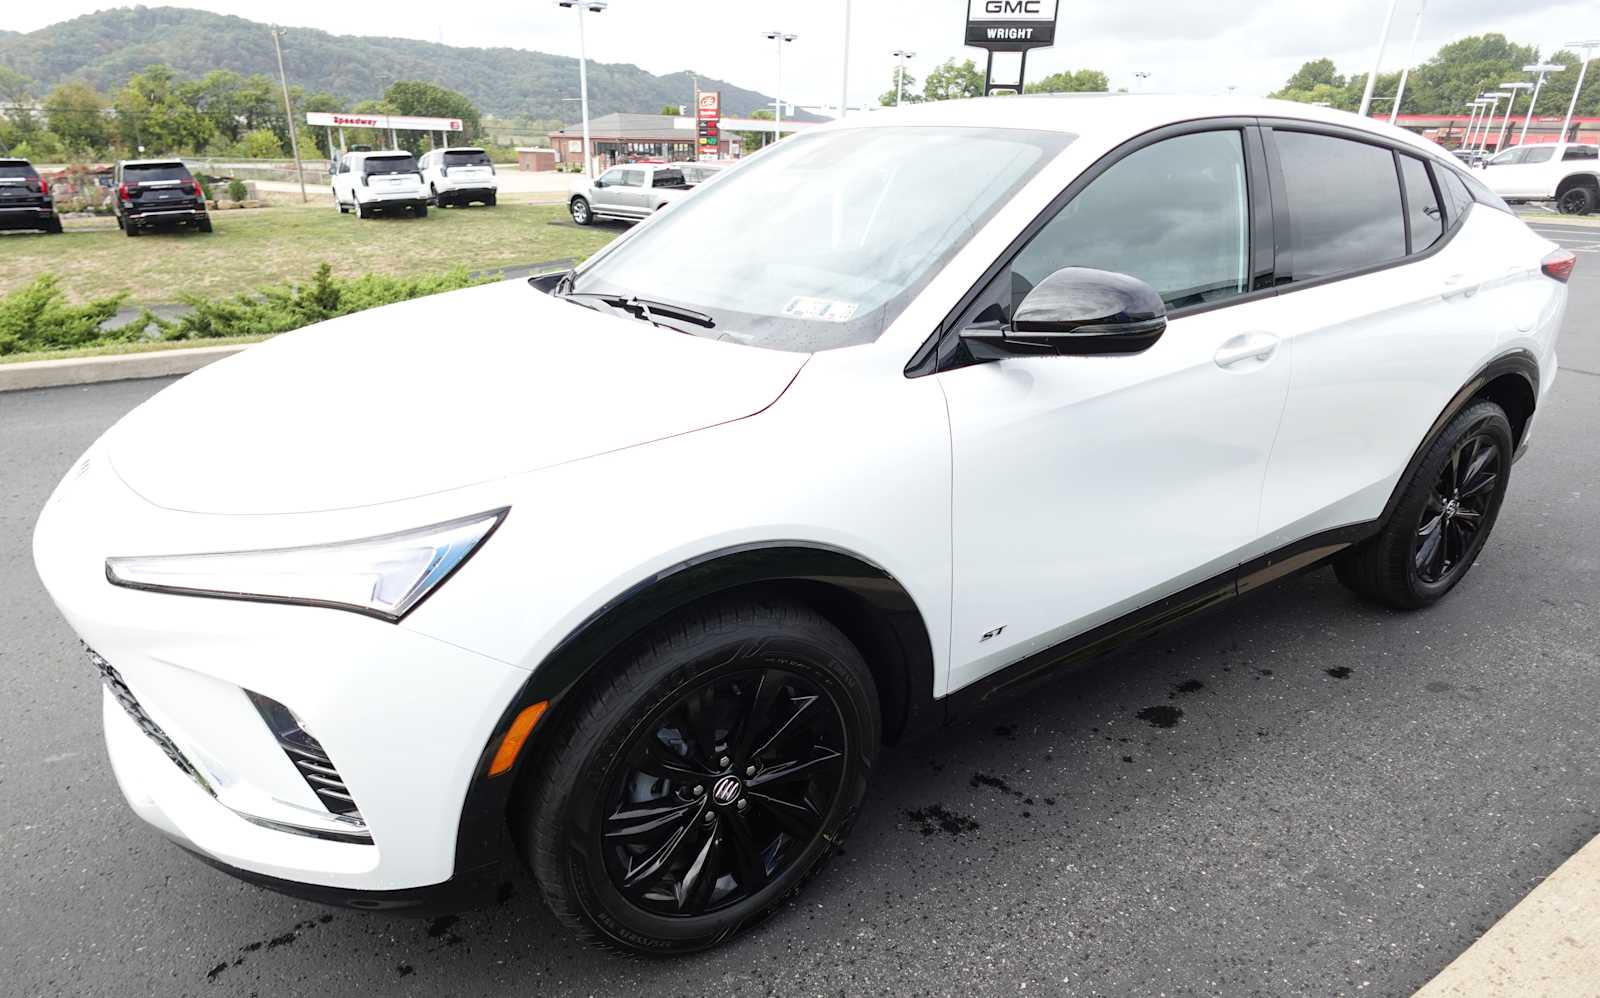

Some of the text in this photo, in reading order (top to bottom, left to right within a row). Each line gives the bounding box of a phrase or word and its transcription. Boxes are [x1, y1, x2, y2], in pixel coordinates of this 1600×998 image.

[985, 0, 1041, 13] GMC
[986, 28, 1033, 39] WRIGHT
[333, 116, 377, 127] Speedway
[979, 624, 1008, 643] ST
